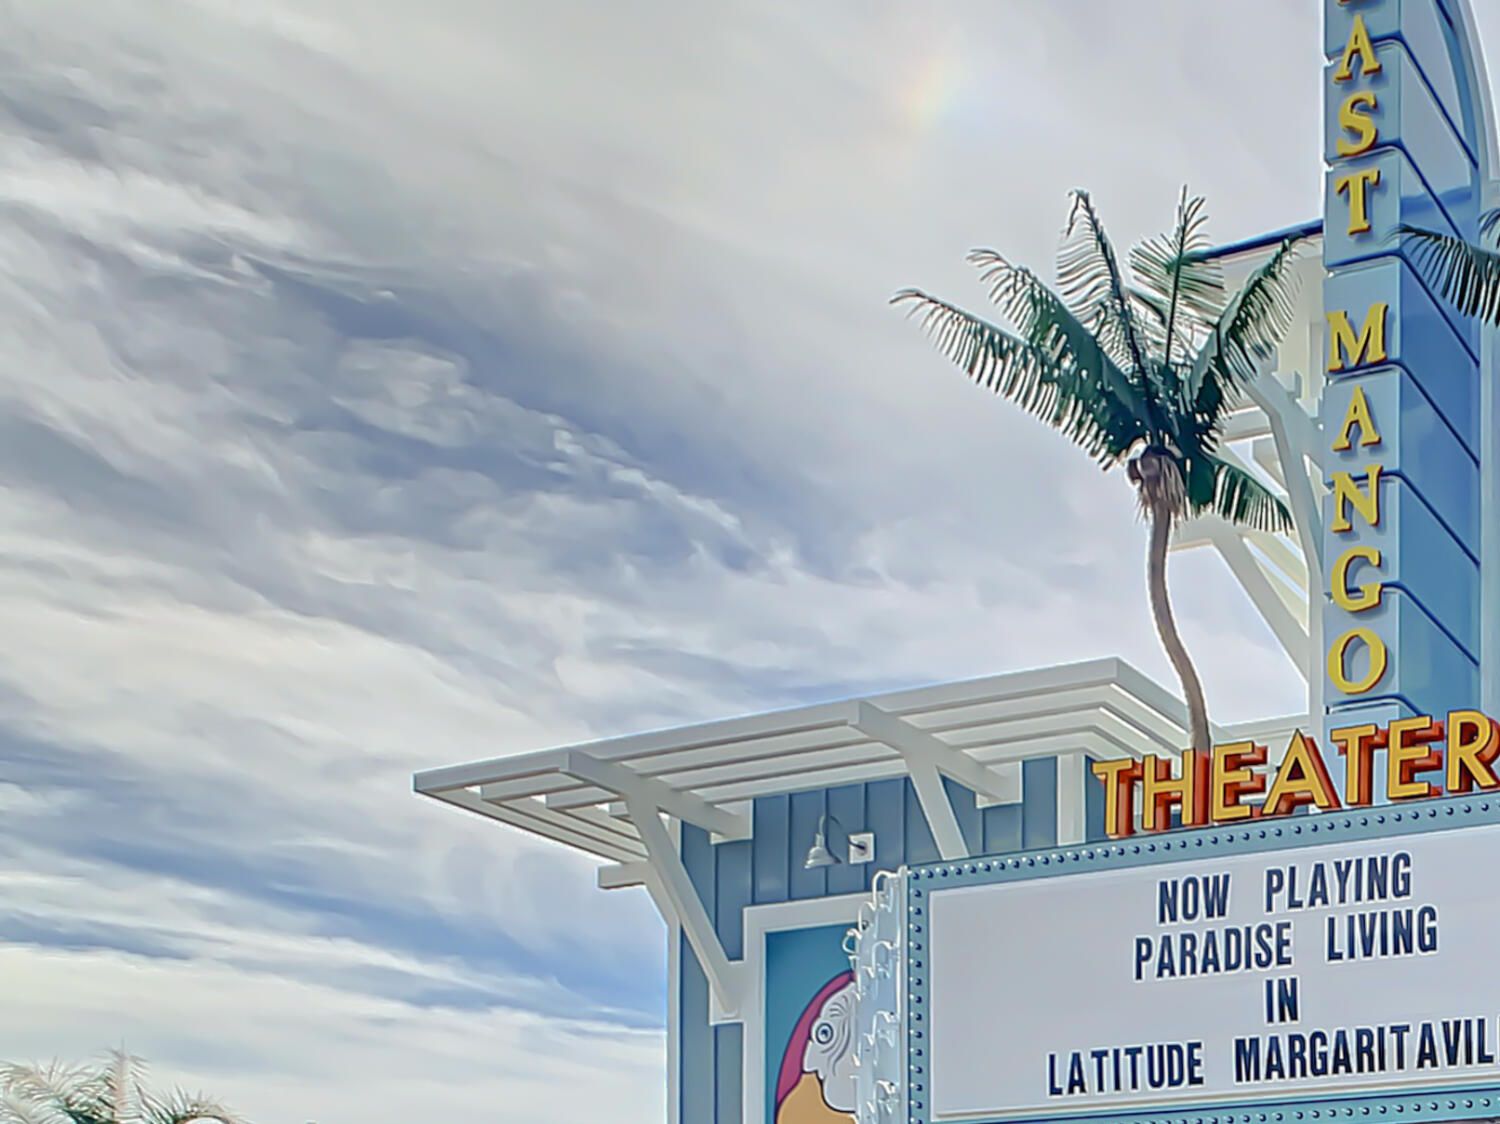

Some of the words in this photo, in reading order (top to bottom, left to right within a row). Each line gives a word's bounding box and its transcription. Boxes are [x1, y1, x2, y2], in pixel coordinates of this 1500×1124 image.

[1333, 0, 1382, 236] AST
[1327, 302, 1388, 695] MANGO
[1158, 874, 1230, 924] NOW
[1265, 852, 1412, 913] PLAYING
[1135, 922, 1293, 980] PARADISE
[1327, 906, 1437, 961] LIVING
[1265, 978, 1298, 1023] IN
[1048, 1043, 1203, 1096] LATITUDE
